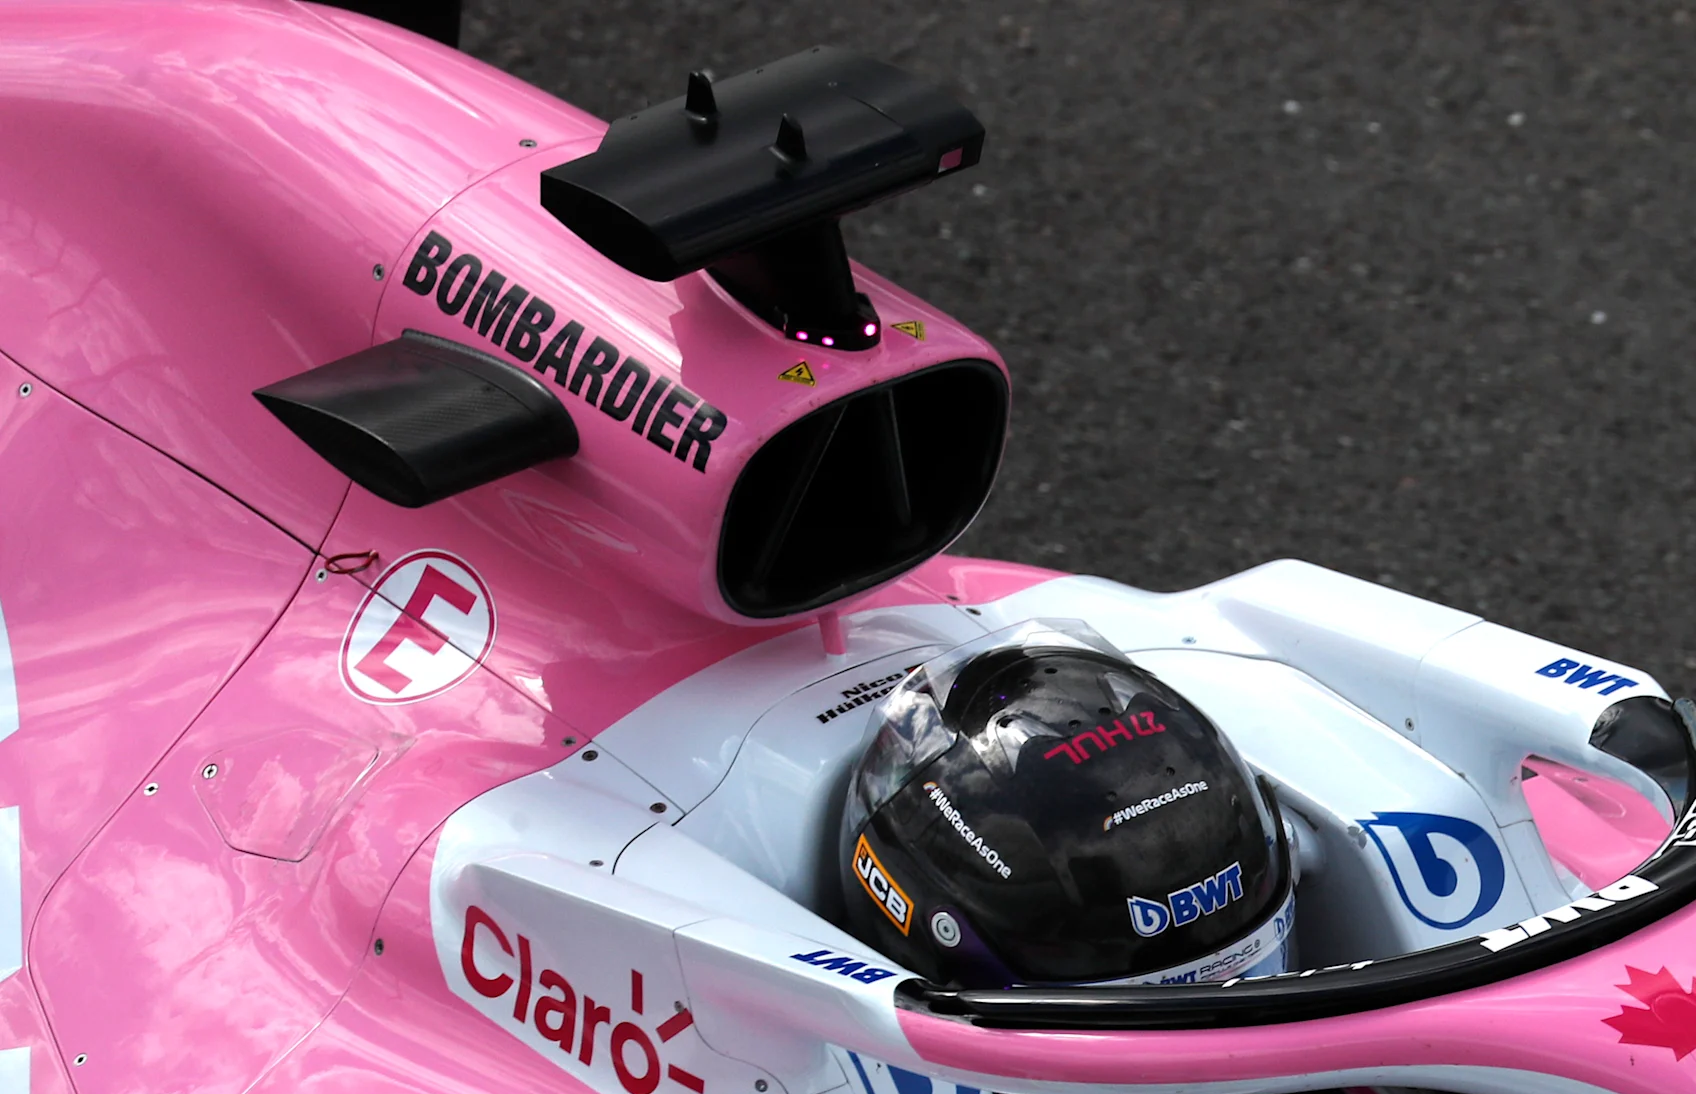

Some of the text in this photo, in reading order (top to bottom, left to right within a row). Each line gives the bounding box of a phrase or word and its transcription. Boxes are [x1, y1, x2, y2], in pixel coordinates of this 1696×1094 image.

[402, 230, 728, 474] BOMBARDIER
[355, 564, 478, 694] E
[841, 672, 904, 699] Nico
[1535, 657, 1639, 697] BWT
[1043, 719, 1134, 765] HUL
[1112, 780, 1209, 825] #WeRaceAsOne
[929, 787, 1012, 879] #WeRaceAsOne
[857, 856, 907, 923] JCB
[1168, 861, 1243, 927] BWT
[789, 950, 898, 984] BWT
